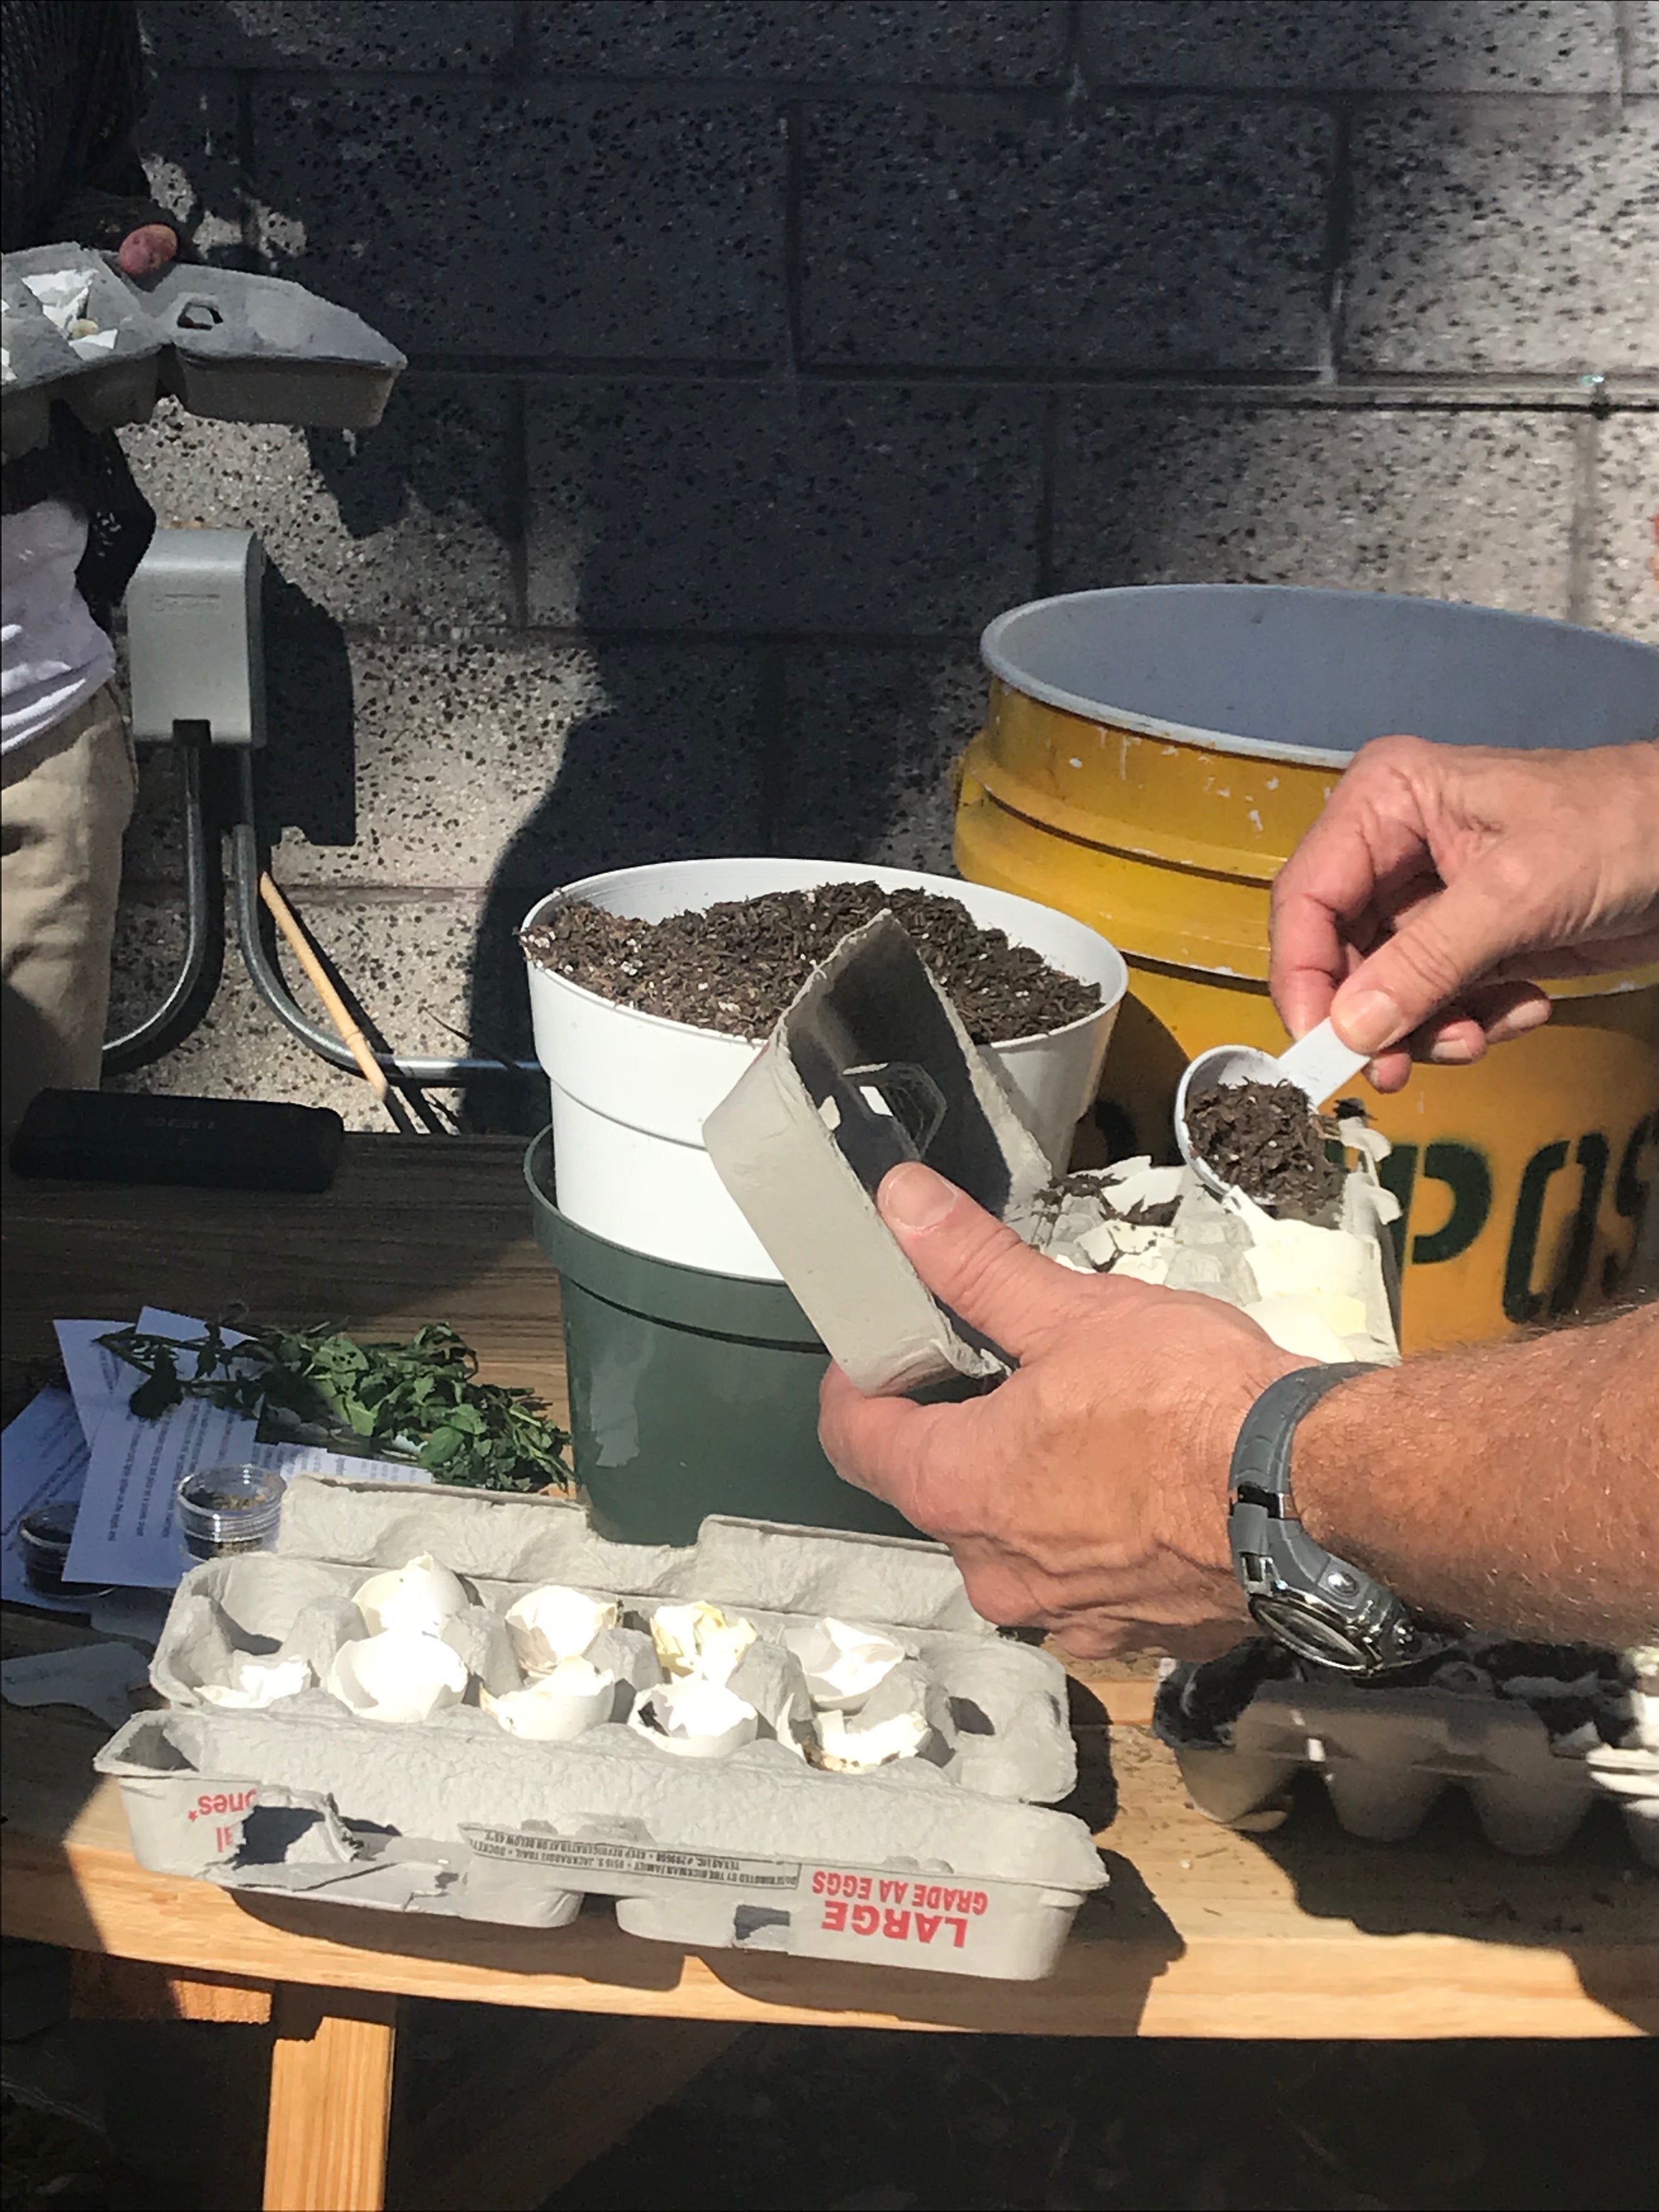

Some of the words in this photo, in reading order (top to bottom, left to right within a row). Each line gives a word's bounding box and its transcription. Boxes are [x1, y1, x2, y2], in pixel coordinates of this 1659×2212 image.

[507, 1835, 535, 1849] BELOW
[537, 1840, 548, 1849] OR
[550, 1842, 559, 1850] AT
[515, 1849, 539, 1860] TRAIL
[561, 1843, 623, 1859] REFRIGERATED
[625, 1850, 646, 1861] KEEP
[541, 1852, 594, 1866] JACKRABBIT
[710, 1859, 740, 1870] TEXAS
[634, 1862, 664, 1874] FAMILY
[710, 1870, 724, 1880] THE
[727, 1873, 737, 1881] BY
[812, 1871, 872, 1900] EGGS
[879, 1880, 909, 1905] AA
[912, 1884, 988, 1916] GRADE
[821, 1900, 968, 1949] LARGE
